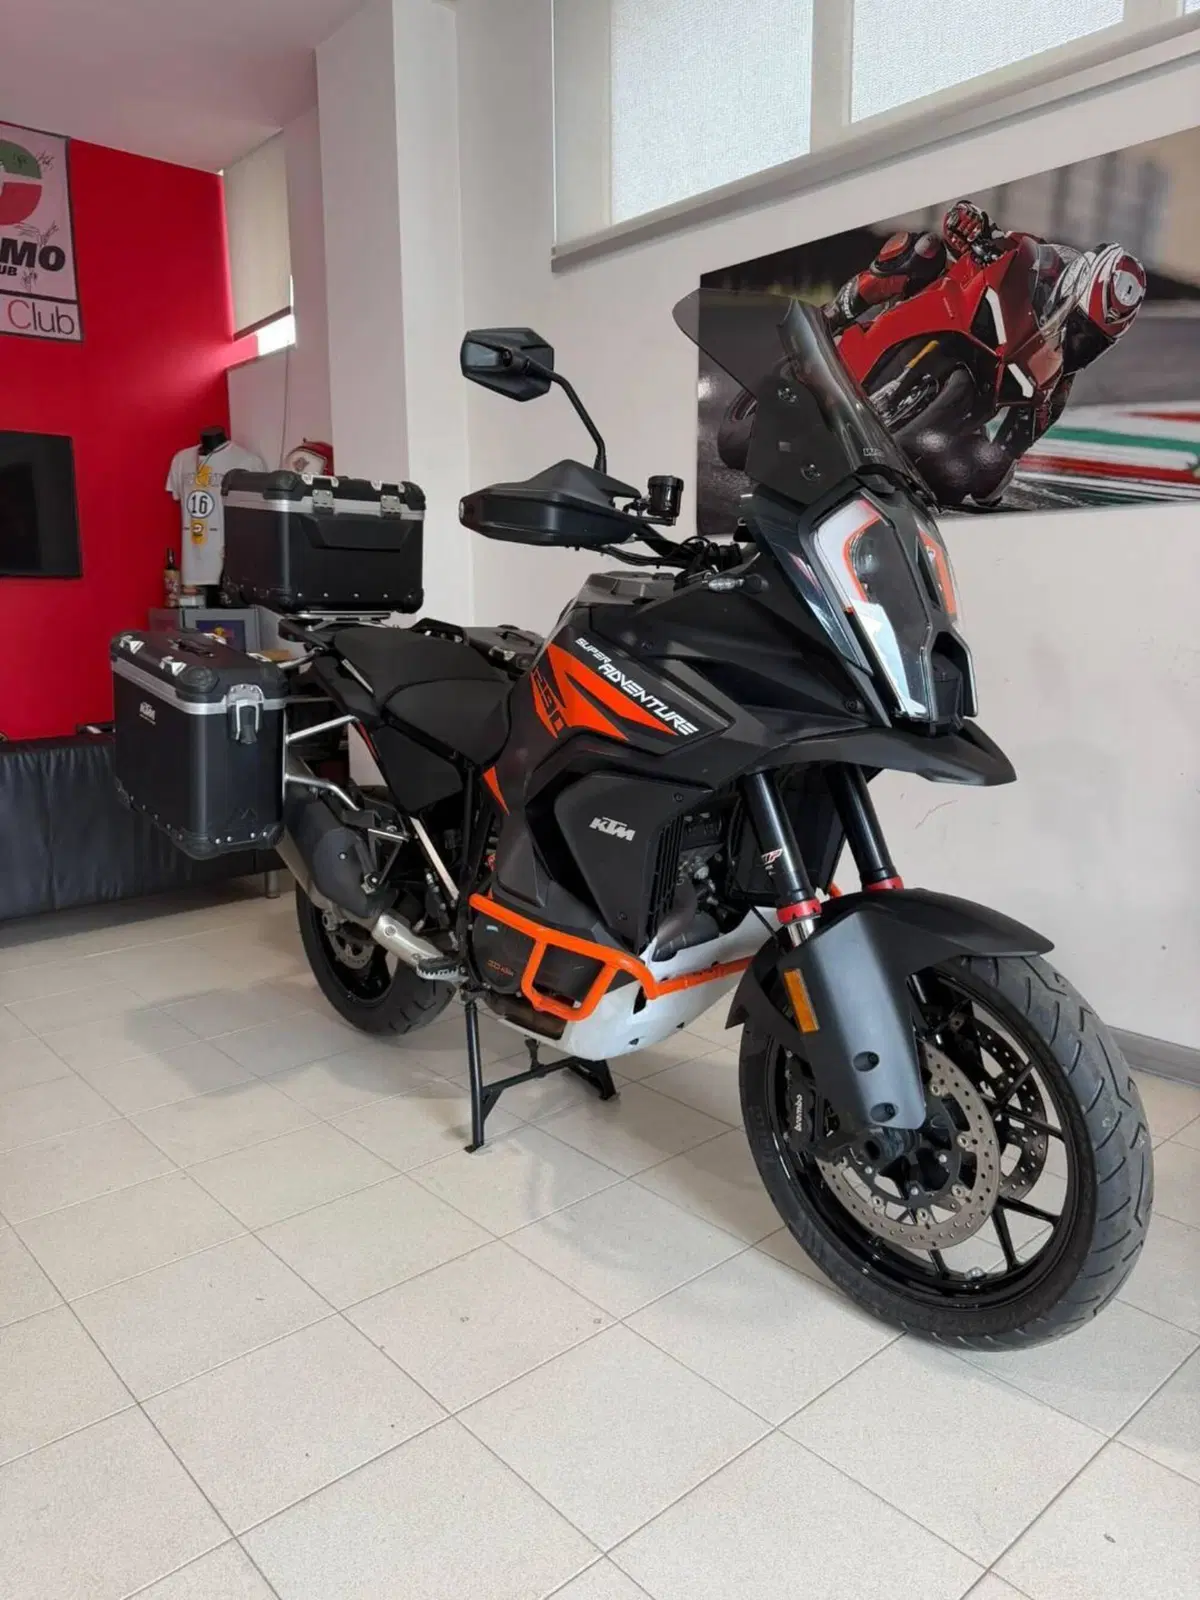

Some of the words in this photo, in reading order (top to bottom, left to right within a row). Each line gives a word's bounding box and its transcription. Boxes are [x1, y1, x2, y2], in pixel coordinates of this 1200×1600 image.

[7, 299, 75, 335] Club
[190, 494, 209, 515] 16
[575, 637, 613, 664] SUPER
[598, 662, 700, 736] ADVENTURE
[588, 815, 637, 843] KTM
[793, 1093, 803, 1133] brembo
